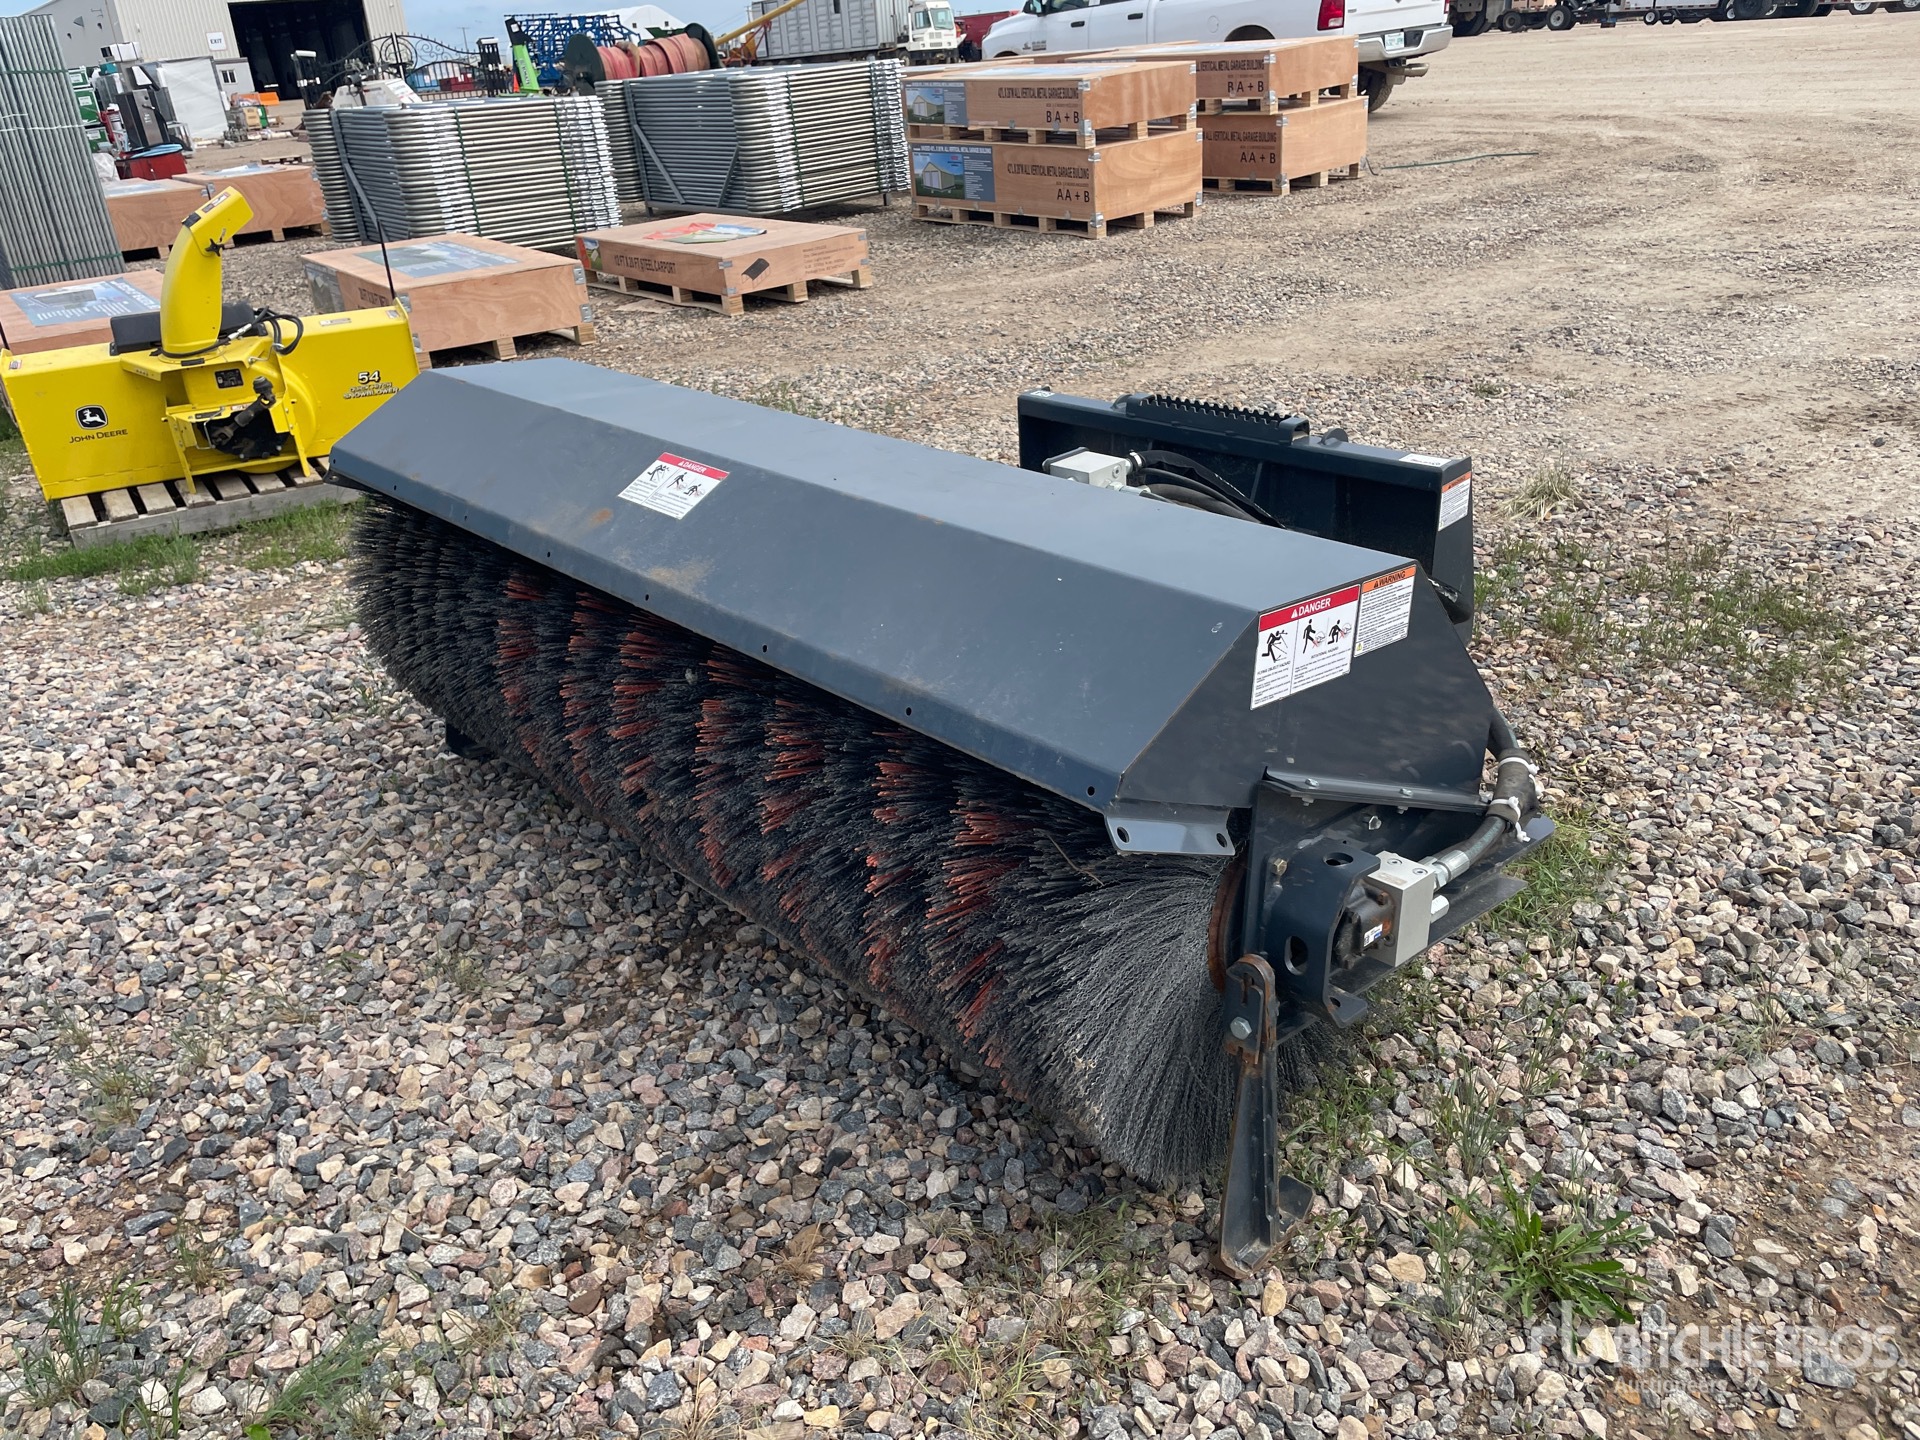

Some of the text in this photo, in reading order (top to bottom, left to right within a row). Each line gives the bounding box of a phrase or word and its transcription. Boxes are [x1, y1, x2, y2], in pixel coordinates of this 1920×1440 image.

[358, 370, 381, 385] 54
[343, 387, 400, 400] SNOWBLOWER
[69, 428, 128, 444] JOHN DEERE
[683, 461, 707, 474] DANGER
[1379, 570, 1406, 587] WARNING
[1298, 597, 1332, 617] DANGER
